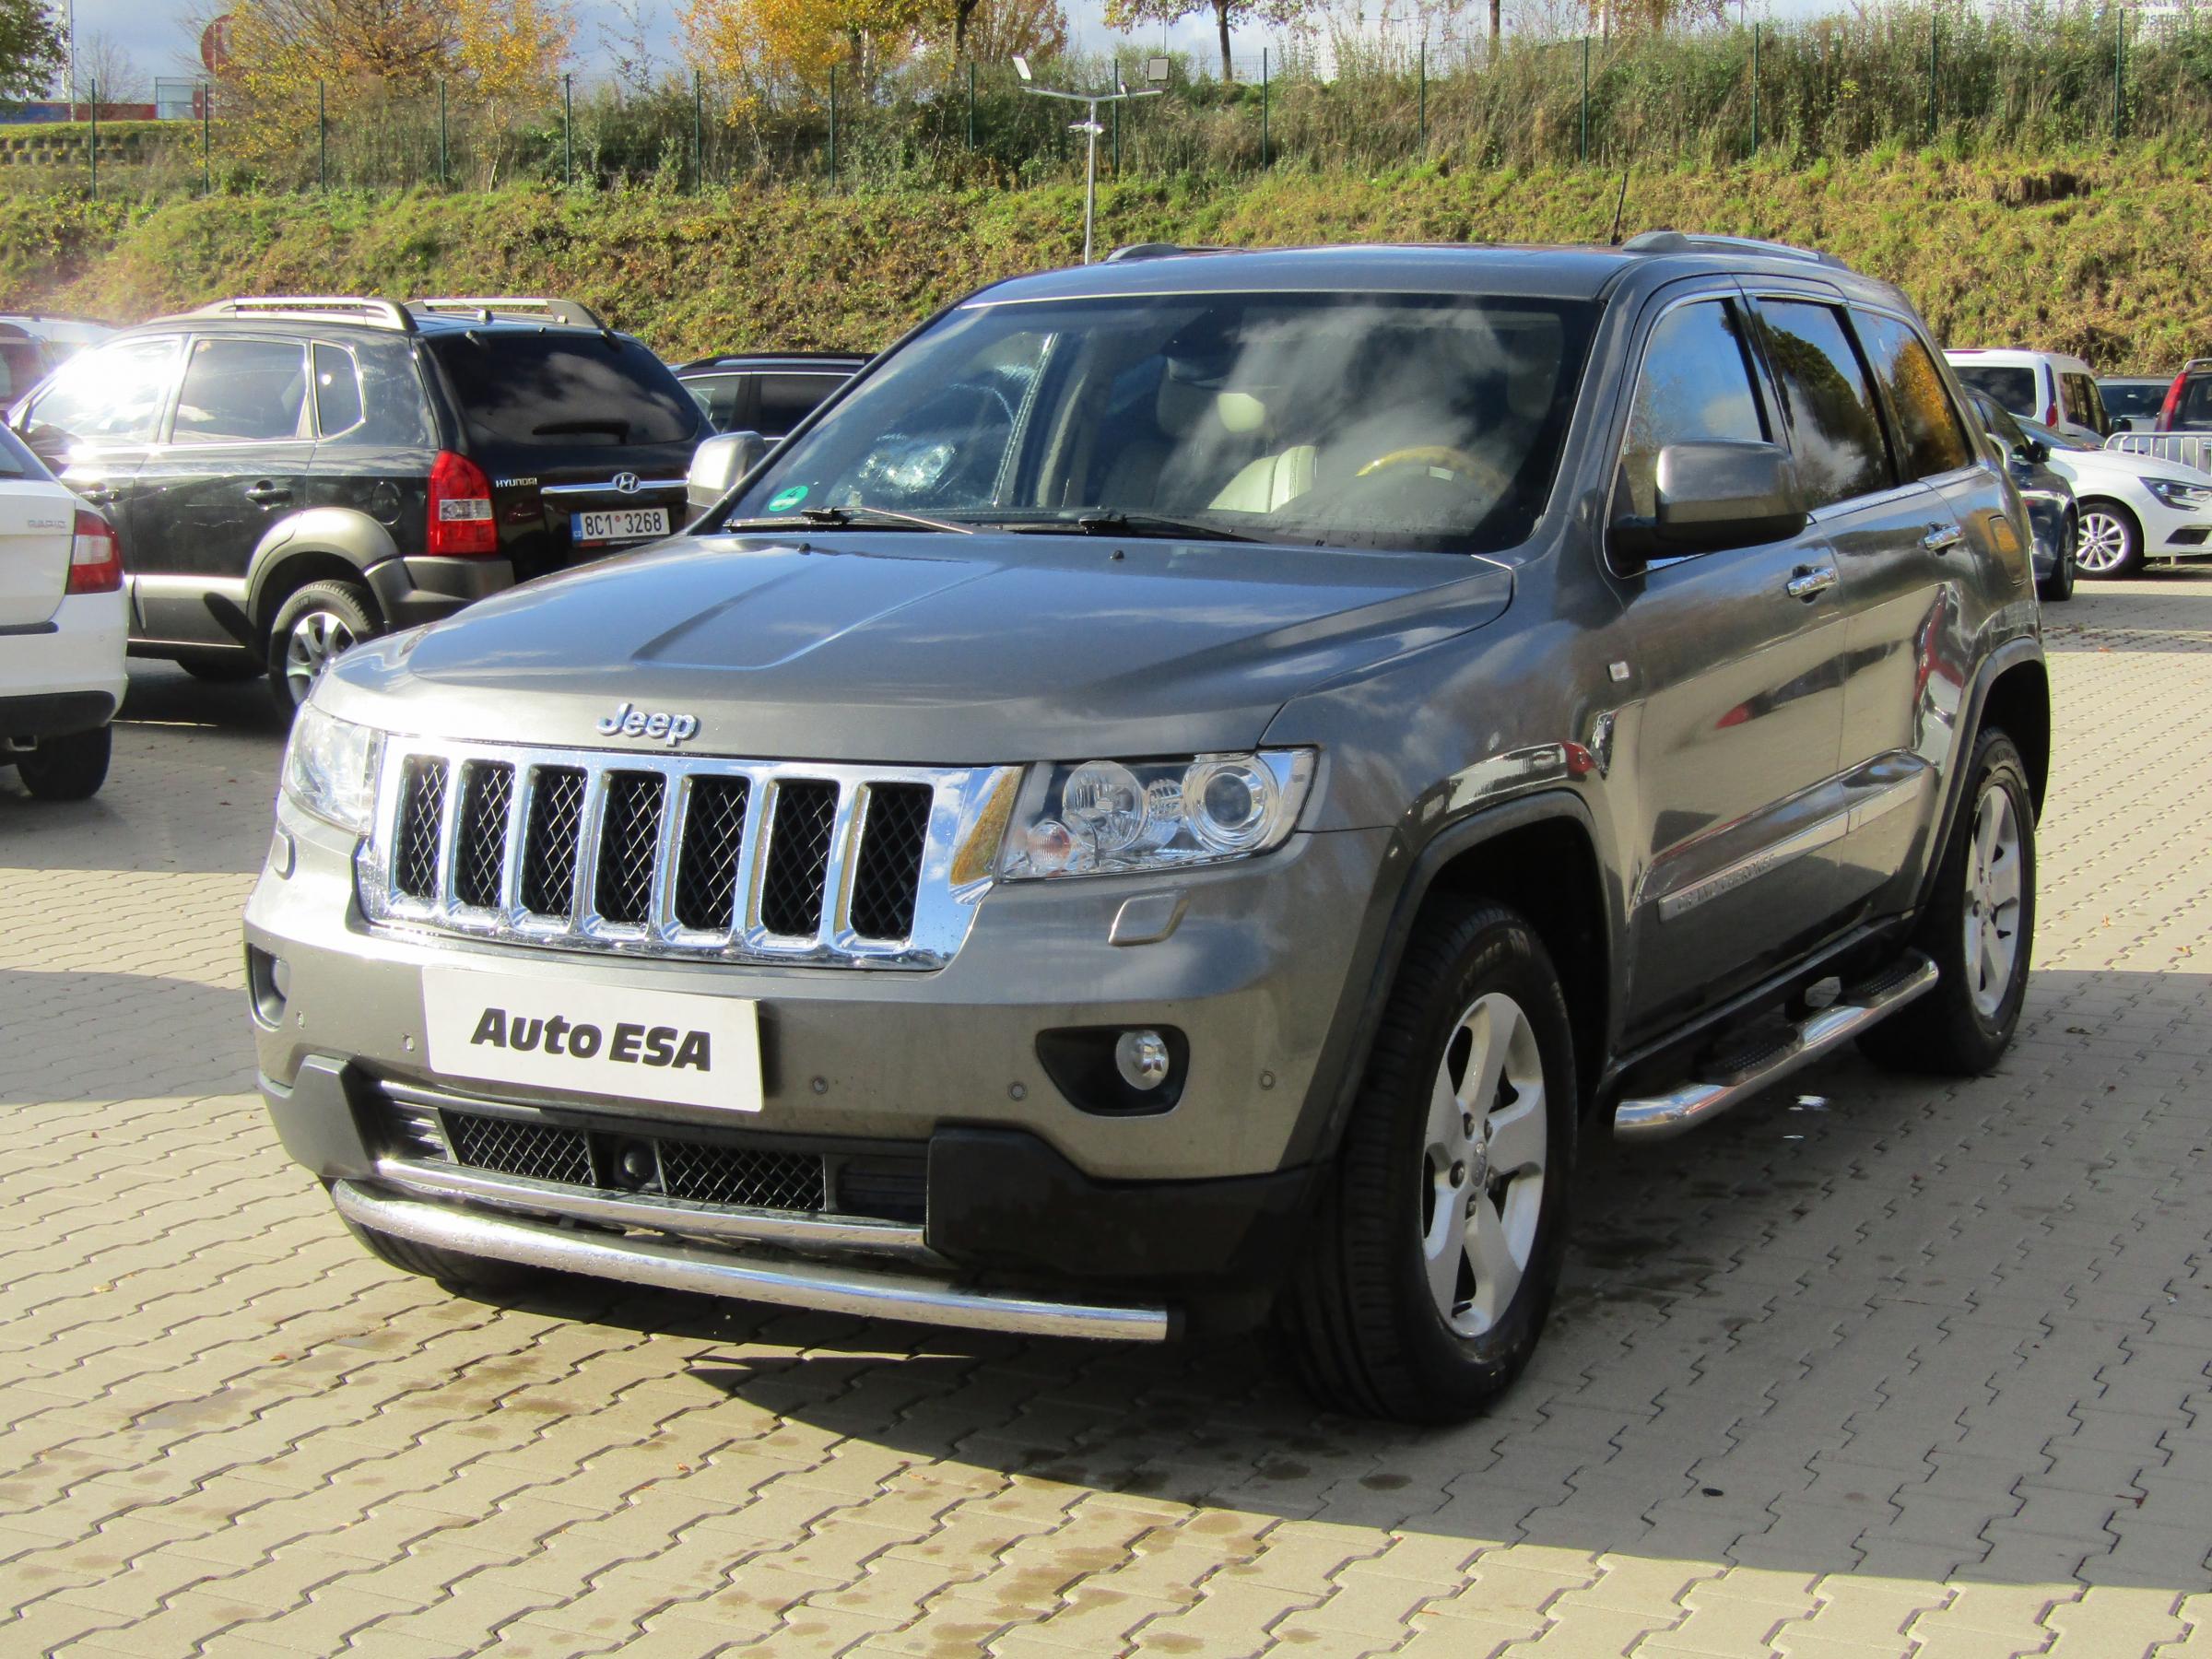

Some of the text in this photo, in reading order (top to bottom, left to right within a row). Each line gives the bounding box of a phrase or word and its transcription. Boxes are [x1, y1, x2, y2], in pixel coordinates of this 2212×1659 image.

[496, 477, 537, 488] HYUNDAI
[585, 512, 663, 535] 8C1 3268
[595, 703, 698, 747] Jeep
[470, 1007, 711, 1072] Auto ESA
